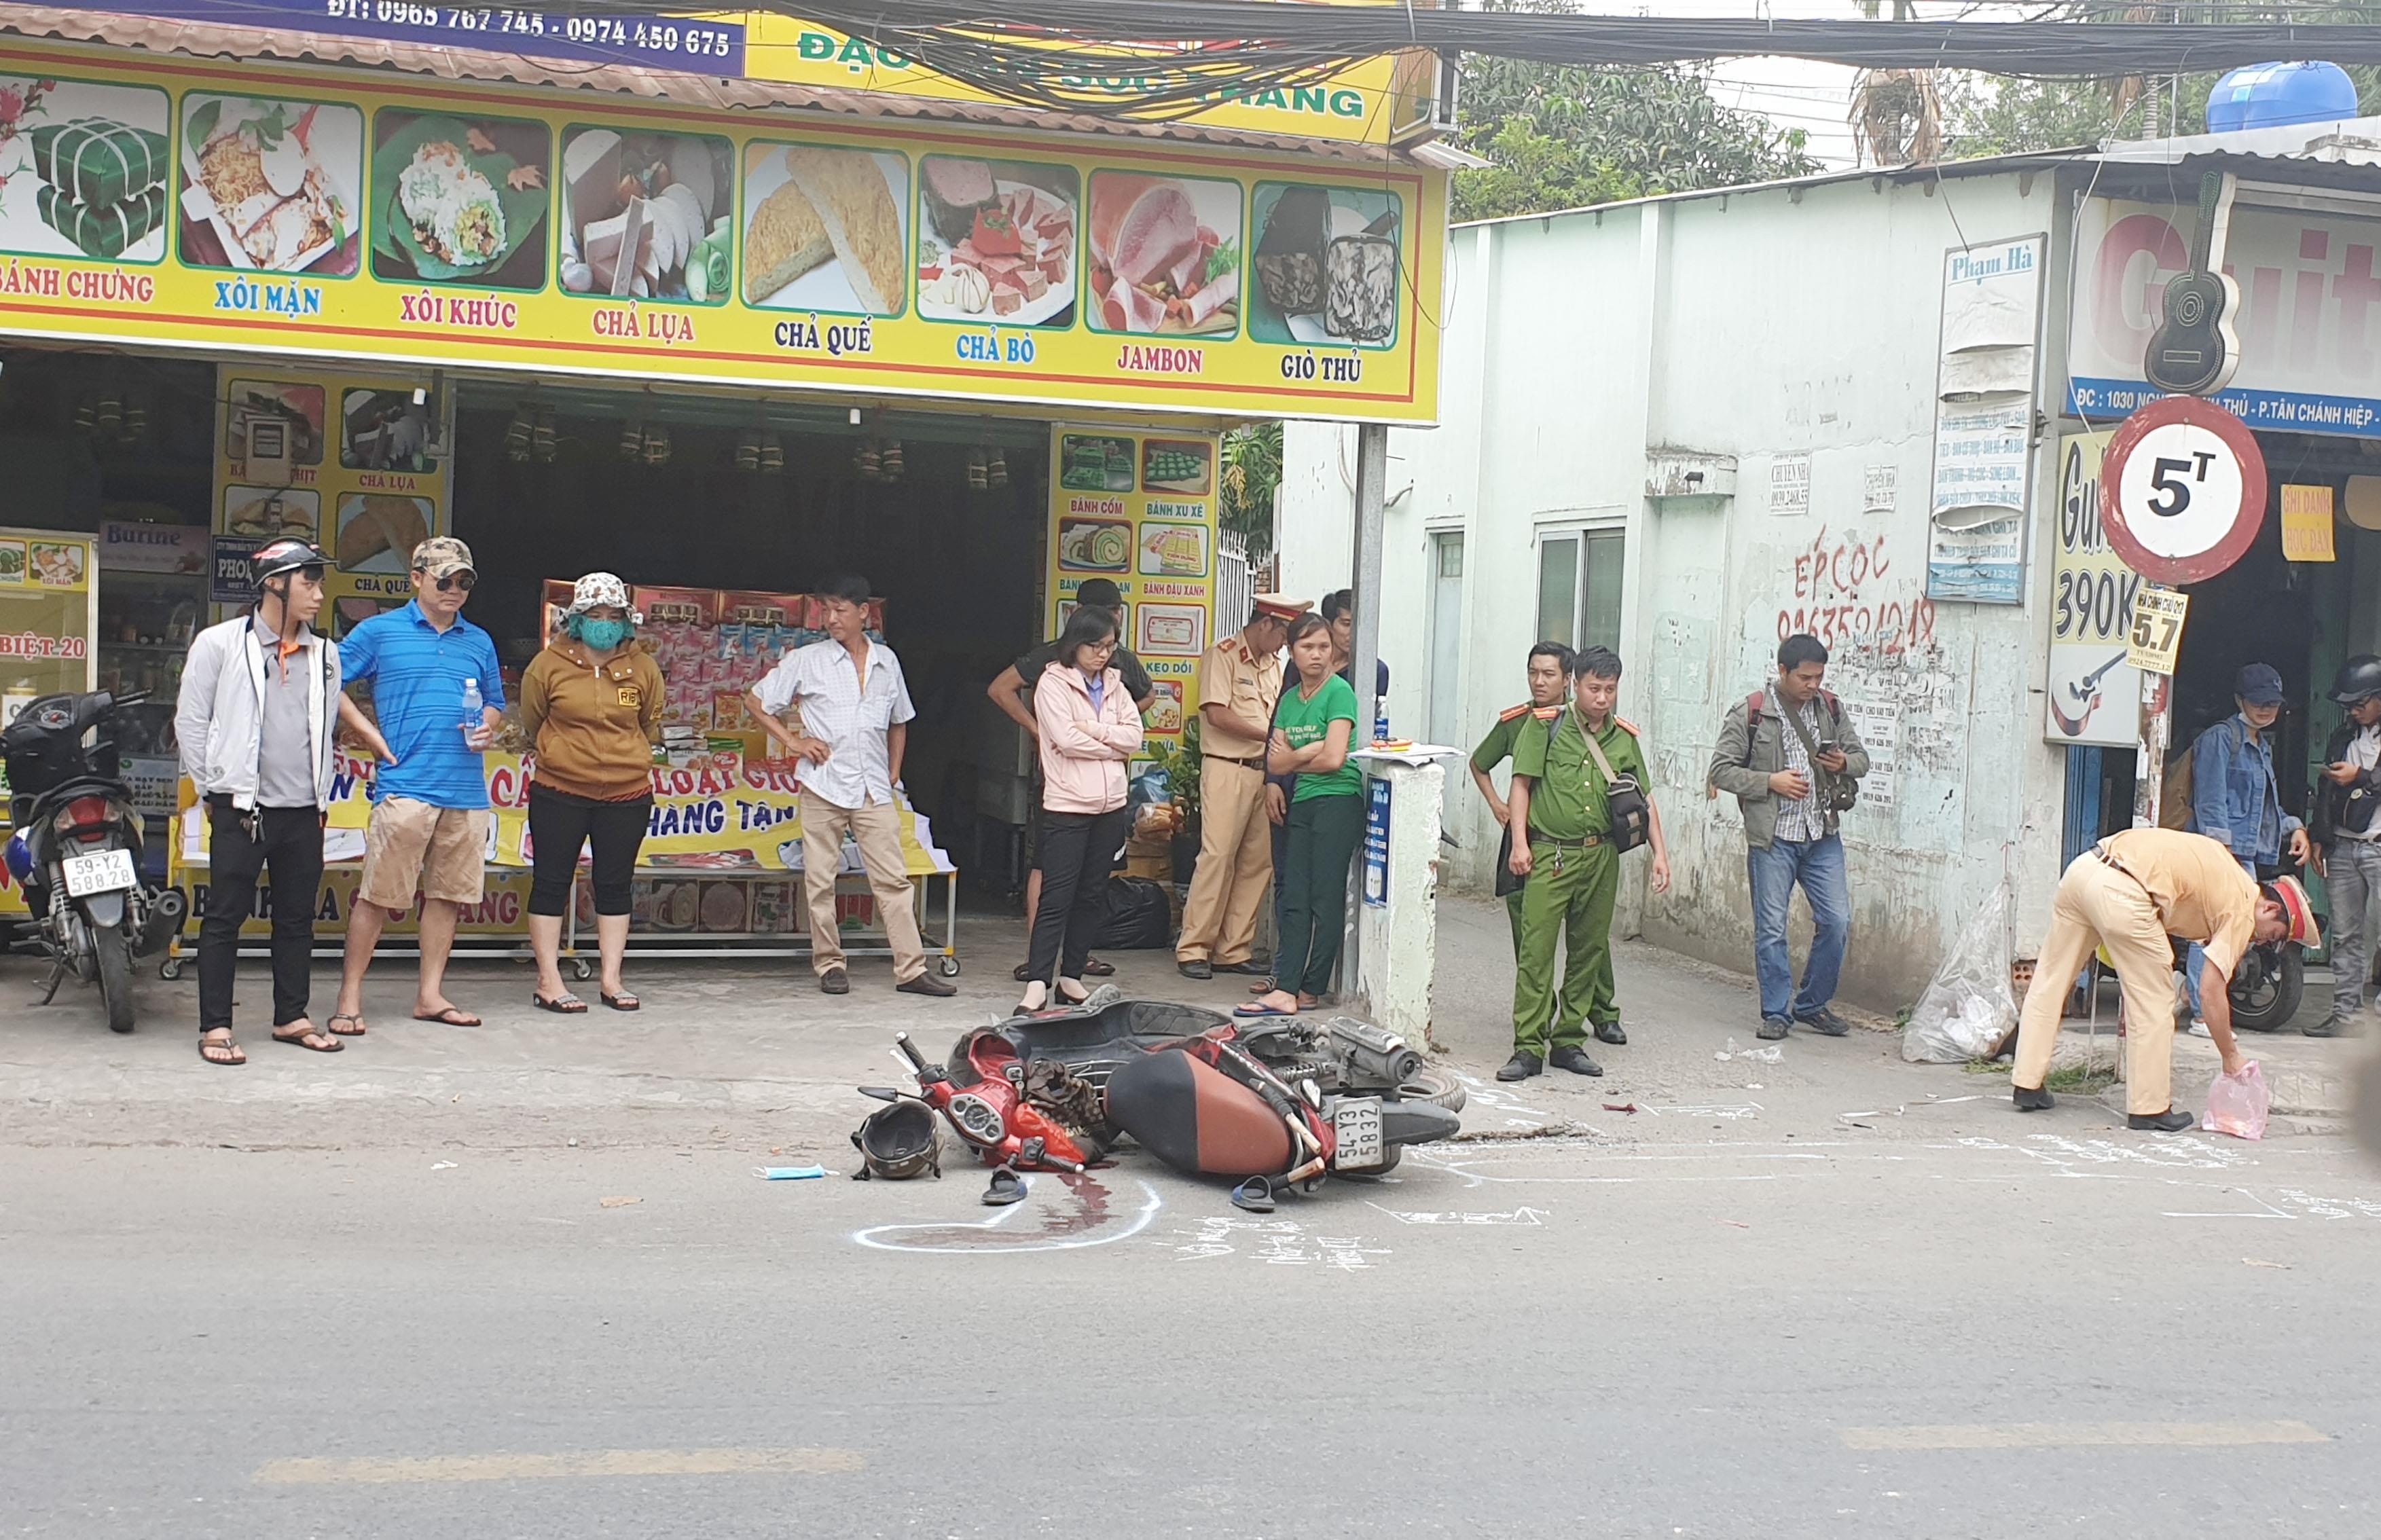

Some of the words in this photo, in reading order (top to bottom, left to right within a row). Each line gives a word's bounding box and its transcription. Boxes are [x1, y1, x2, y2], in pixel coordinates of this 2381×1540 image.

[377, 0, 438, 26] 0965
[500, 10, 544, 37] 745
[566, 18, 627, 45] 0974
[685, 30, 729, 56] 675
[2007, 244, 2033, 271] Hà
[0, 258, 60, 296] ÁNH
[67, 268, 153, 302] CHƯNG
[214, 276, 257, 310] XÔI
[264, 279, 321, 318] MẶN
[401, 289, 443, 323] XÔI
[449, 294, 516, 328] KHÚC
[593, 300, 640, 337] CHẢ
[647, 313, 694, 344] LỤA
[774, 313, 819, 348] CHẢ
[826, 315, 873, 356] QUẾ
[956, 326, 1000, 361] CHẢ
[1006, 332, 1036, 363] BÒ
[1117, 344, 1203, 373] JAMBON
[1281, 350, 1315, 380] GIÒ
[1321, 348, 1362, 382] THỦ
[2106, 391, 2134, 409] 1030
[2258, 400, 2296, 420] P.TÂN
[2297, 400, 2342, 424] CHÁNH
[2343, 403, 2373, 429] HIỆP
[359, 469, 386, 488] CHẢ
[389, 476, 416, 490] LỤA
[1070, 497, 1099, 514] BÁNH
[1101, 497, 1123, 515] CỐM
[1146, 500, 1173, 517] BÁNH
[1176, 505, 1188, 517] XU
[355, 574, 381, 591] CHẢ
[1144, 582, 1165, 595] BÁNH
[1184, 586, 1205, 597] XANH
[2055, 570, 2140, 638] 390K
[60, 638, 86, 657] 20
[2132, 612, 2179, 653] 5.7
[1146, 661, 1169, 676] KẸO
[735, 799, 795, 831] TẬN
[71, 868, 131, 894] 588.28
[75, 855, 122, 875] 59-Y2
[1338, 1110, 1358, 1158] 54-Y3
[1359, 1107, 1378, 1156] 5832
